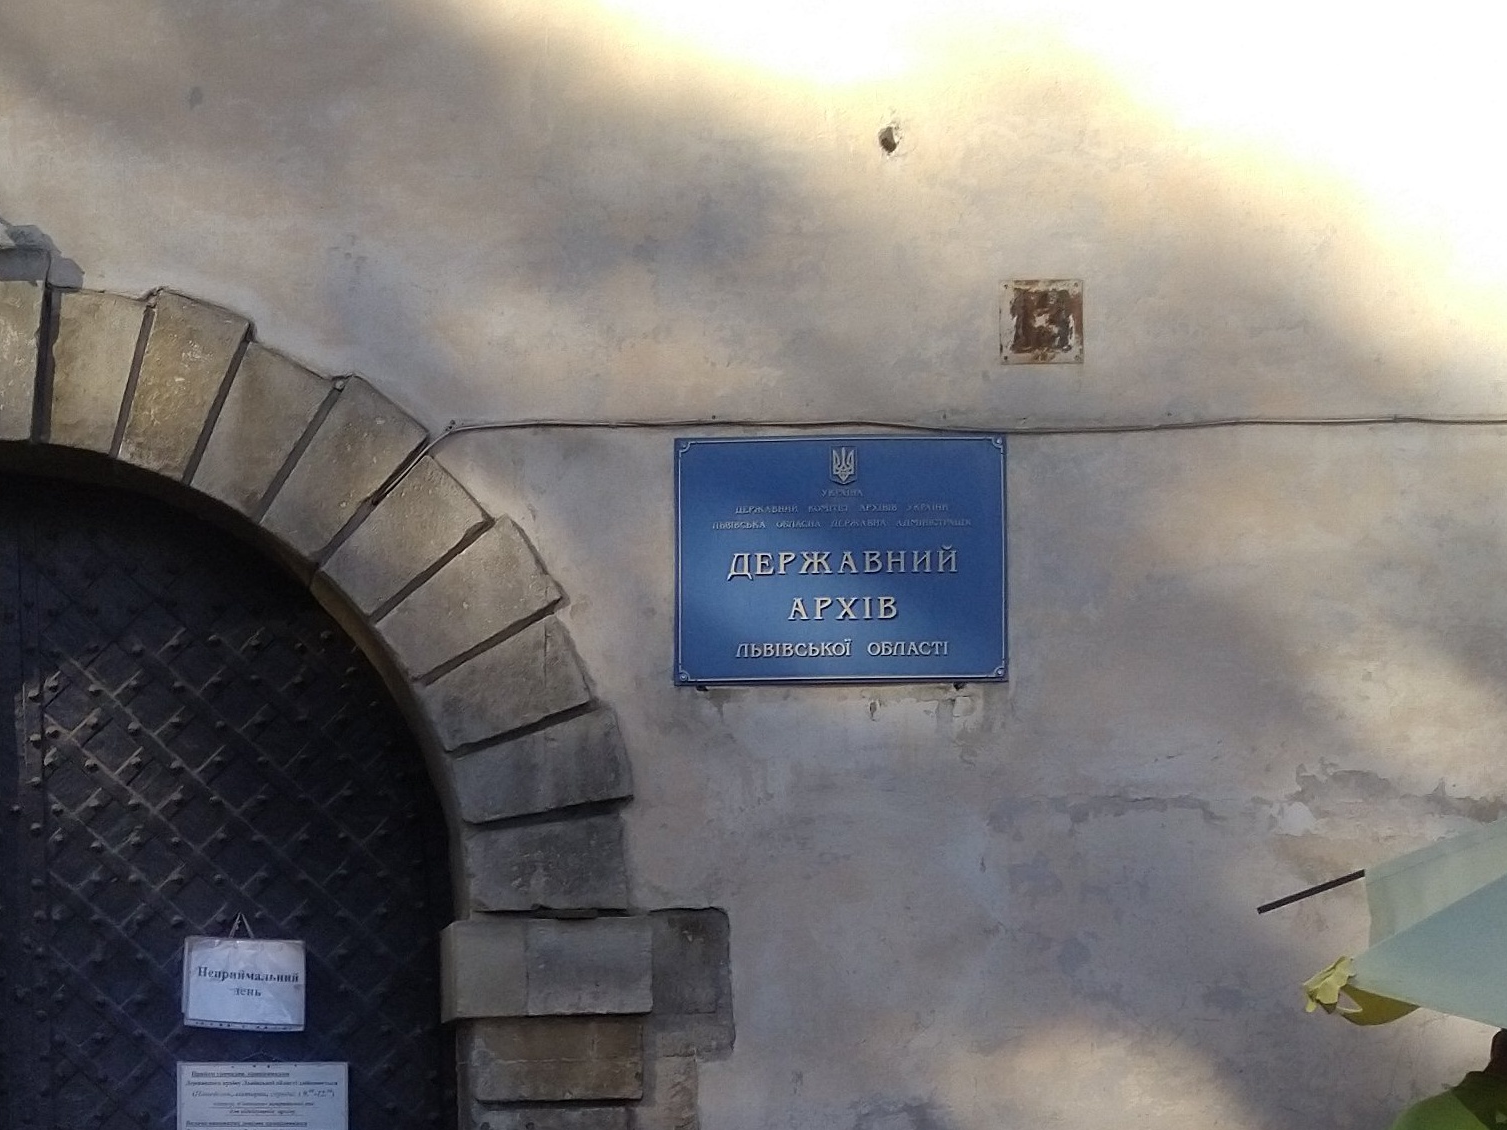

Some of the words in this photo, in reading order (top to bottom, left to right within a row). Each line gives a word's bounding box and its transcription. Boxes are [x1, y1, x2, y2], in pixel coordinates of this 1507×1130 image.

[727, 545, 958, 580] ДЕРЖАВНИЙ
[788, 596, 898, 621] АРХІВ
[735, 638, 852, 659] ЛЬВІВСЬКОЇ
[867, 640, 949, 657] ОБЛАСТІ
[197, 966, 299, 983] Неприймальний
[235, 986, 262, 998] день
